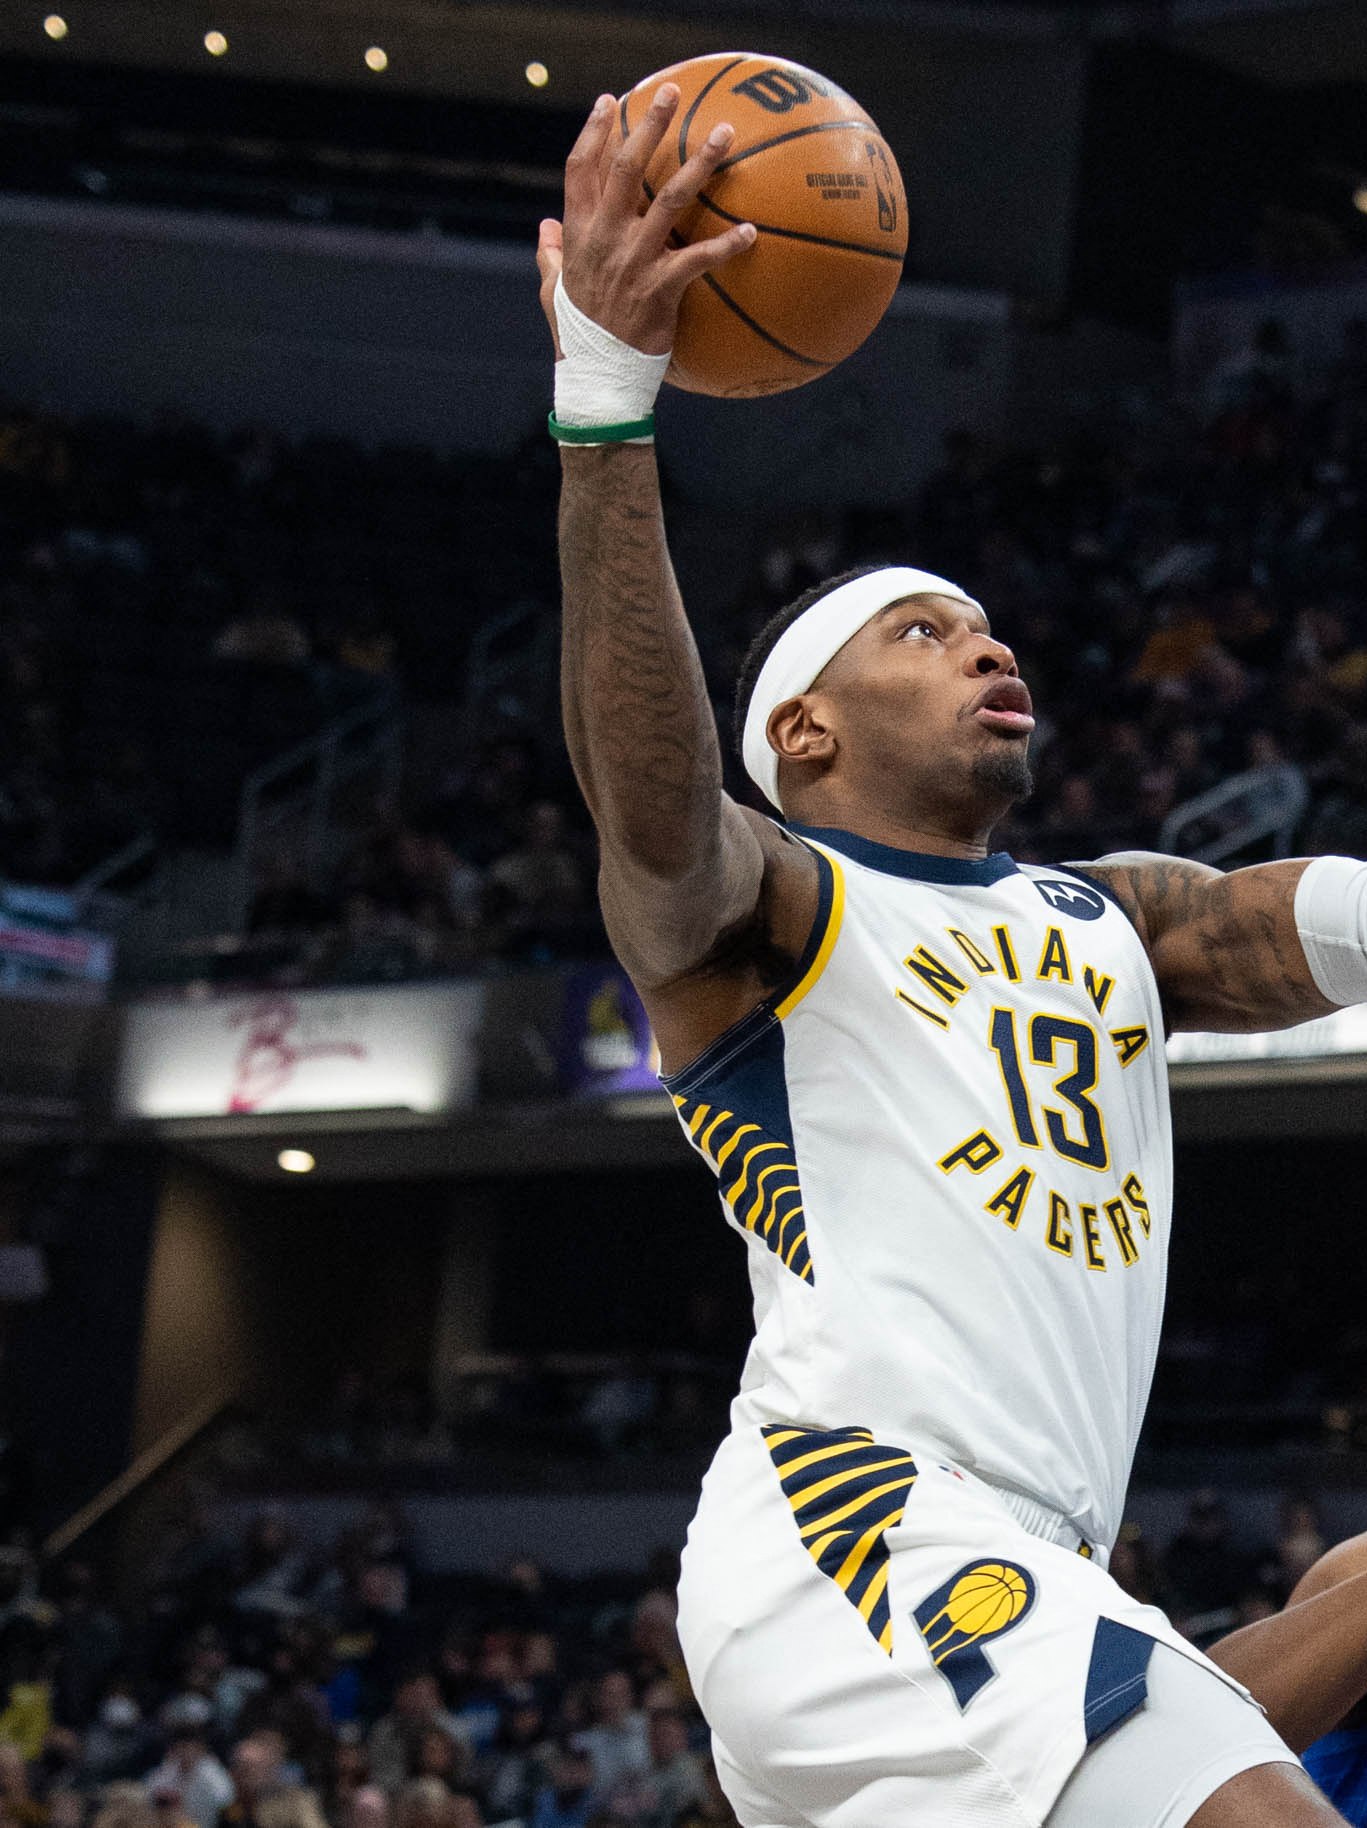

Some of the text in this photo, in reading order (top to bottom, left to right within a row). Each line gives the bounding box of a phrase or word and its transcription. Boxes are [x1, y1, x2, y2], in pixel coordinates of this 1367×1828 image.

[895, 924, 1150, 1069] INDIANA
[988, 1005, 1110, 1172] 13
[937, 1127, 1151, 1271] PACERS
